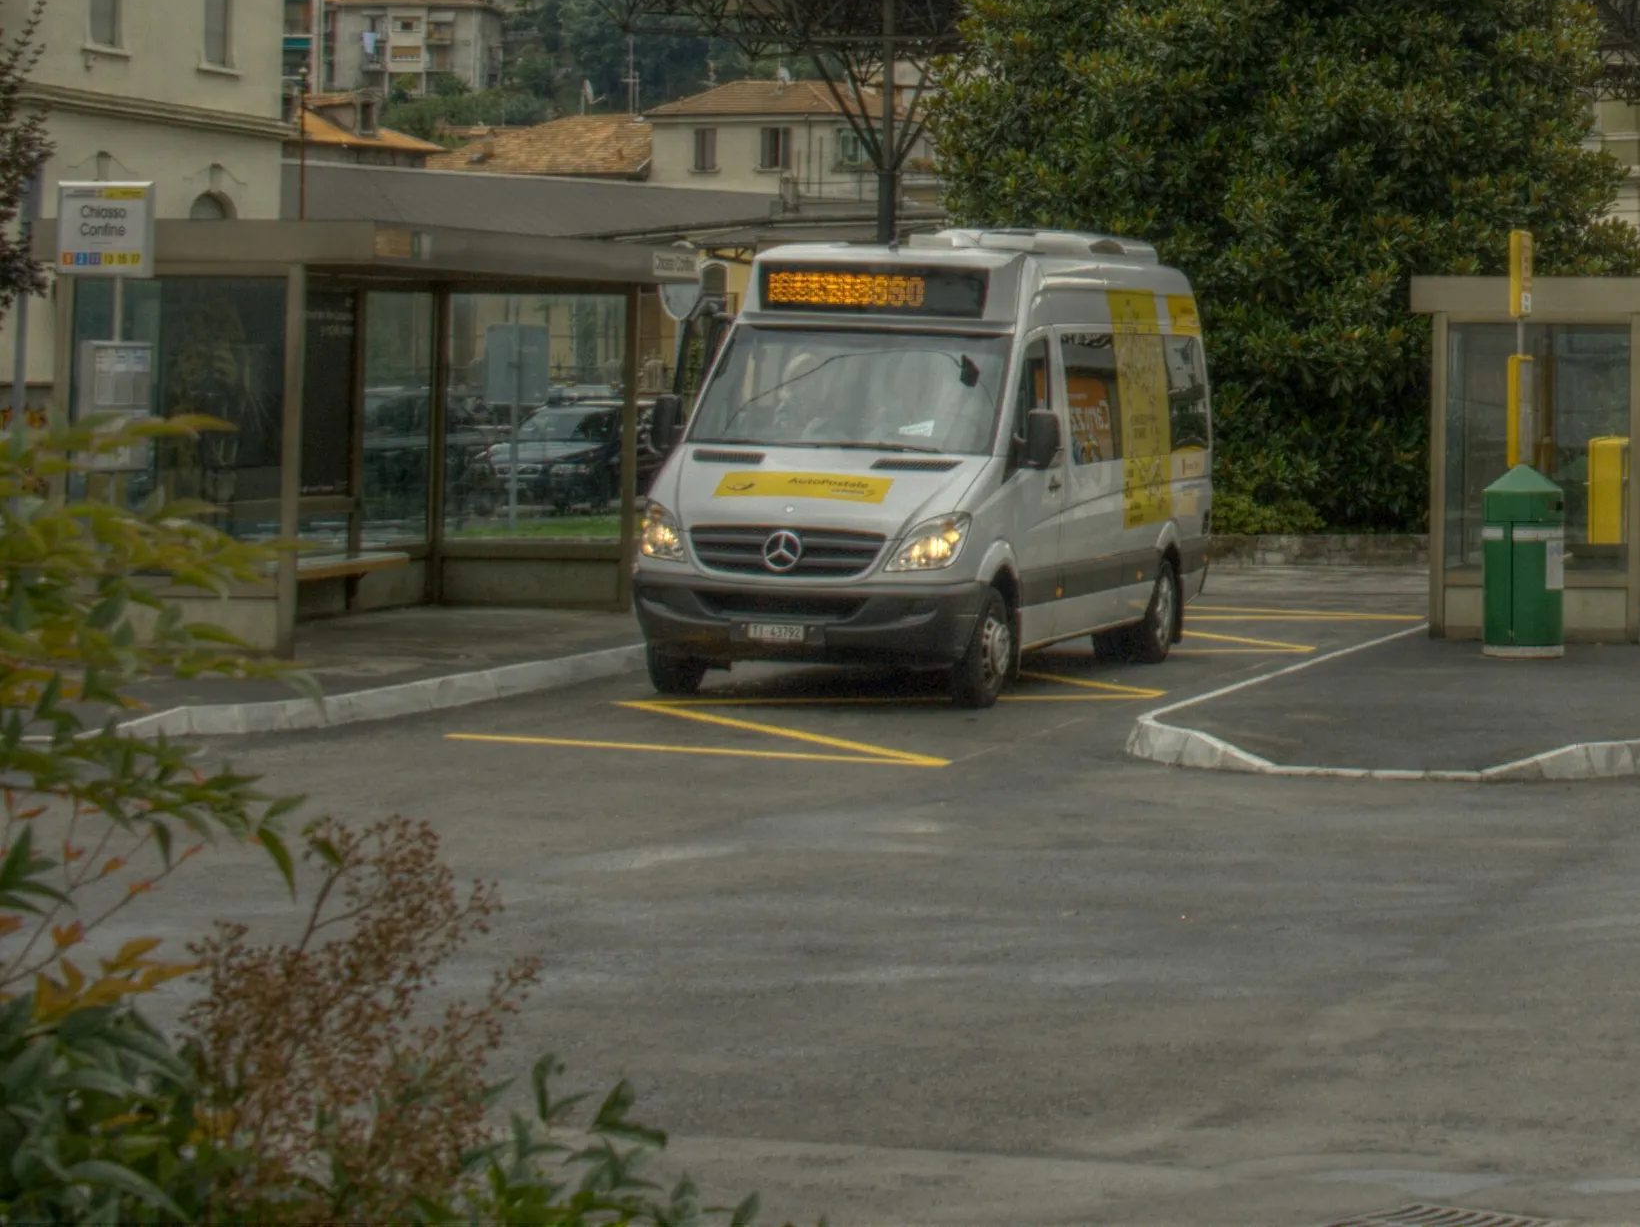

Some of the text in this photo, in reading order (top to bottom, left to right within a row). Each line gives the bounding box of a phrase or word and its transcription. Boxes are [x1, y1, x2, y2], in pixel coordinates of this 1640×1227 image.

[80, 204, 127, 219] Chiasso
[79, 222, 126, 237] Confine
[787, 476, 869, 489] AutoPostale
